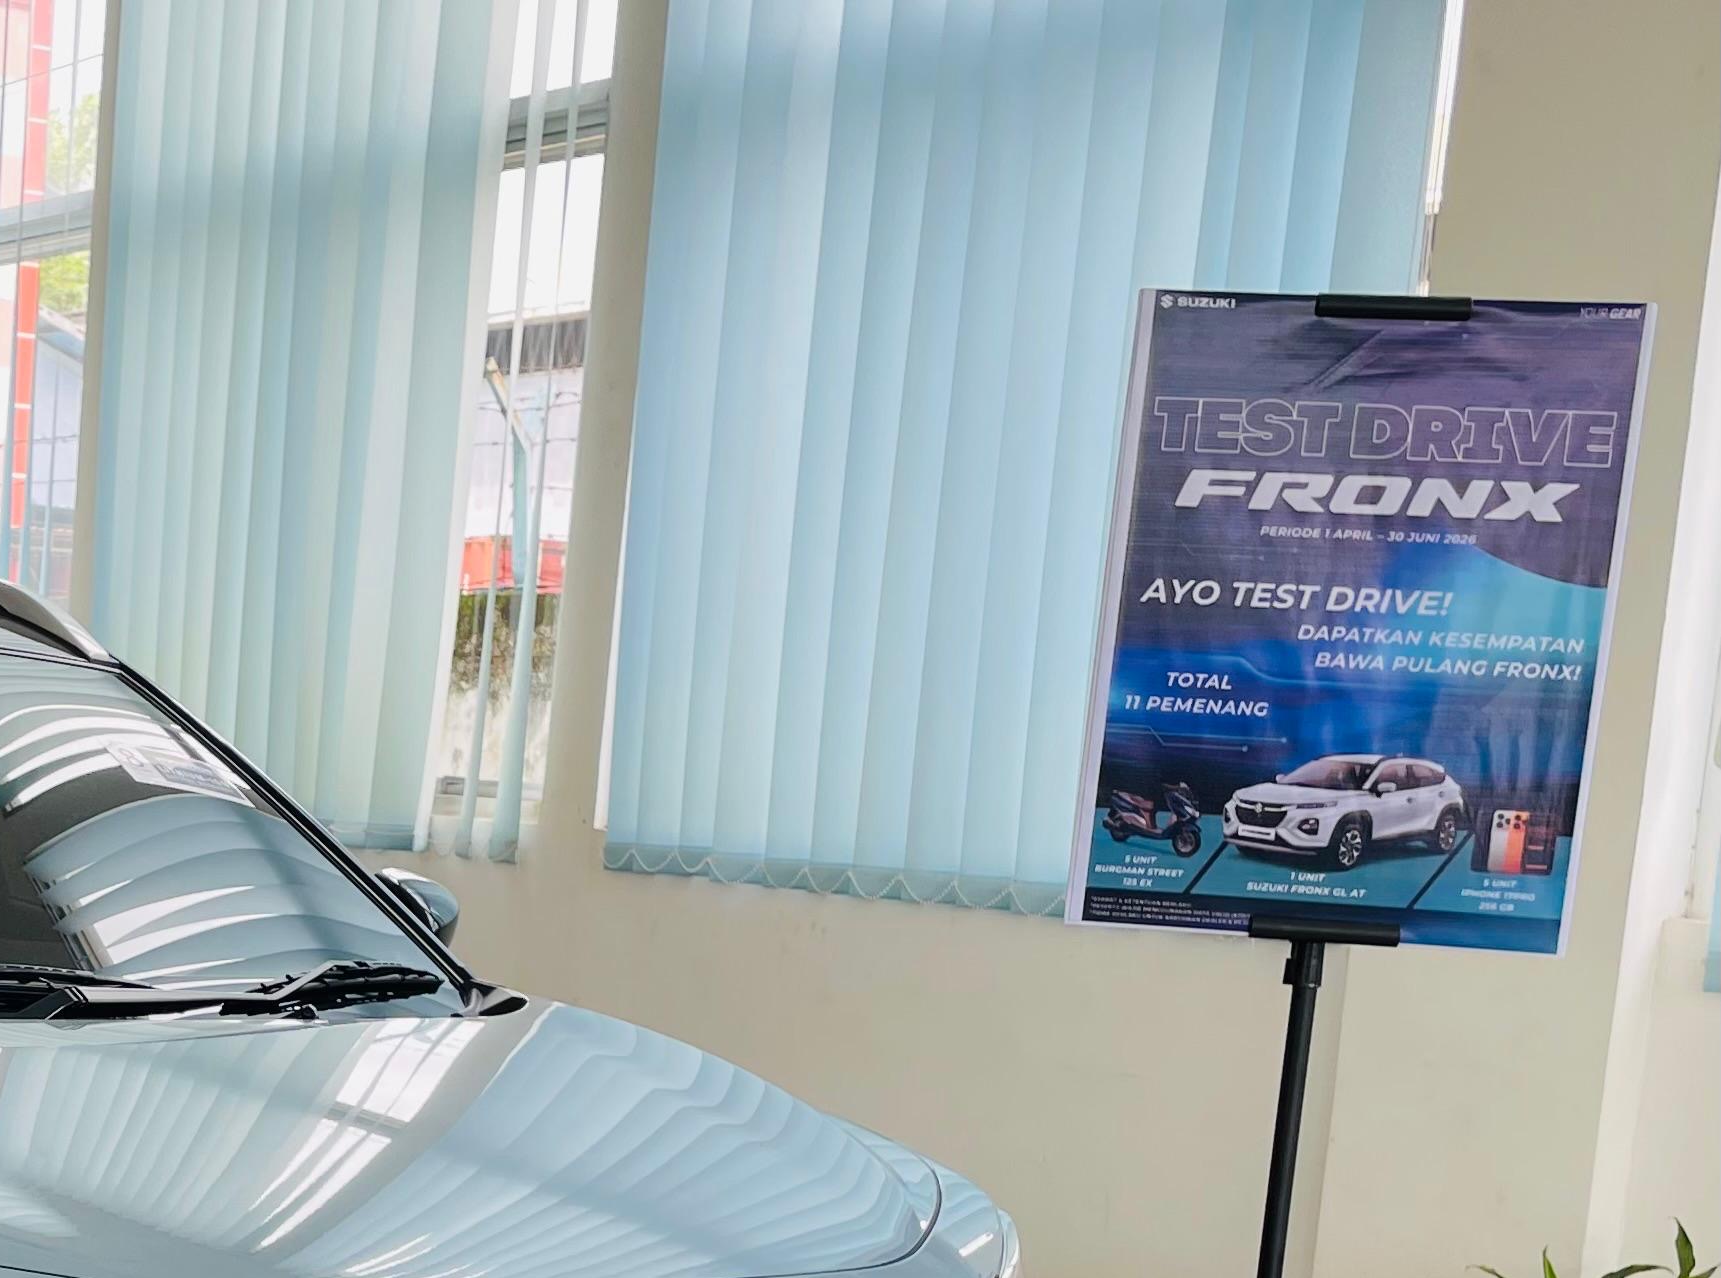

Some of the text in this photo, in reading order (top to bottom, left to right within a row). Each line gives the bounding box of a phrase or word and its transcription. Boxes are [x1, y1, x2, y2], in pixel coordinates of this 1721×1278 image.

[1177, 296, 1236, 309] SUZUKI
[1609, 307, 1641, 320] GEAR
[1154, 396, 1618, 468] TEST DRIVE
[1175, 468, 1580, 522] FRONX
[1260, 525, 1320, 539] PERIODE
[1324, 528, 1330, 538] 1
[1332, 528, 1373, 541] APRIL
[1387, 531, 1404, 542] 30
[1406, 532, 1441, 543] JUNI
[1140, 578, 1454, 617] AYO TEST DRIVE!
[1297, 624, 1585, 654] DAPATKAN KESEMPATAN
[1314, 651, 1582, 681] BAWA PULANG FRONX!
[1166, 671, 1232, 690] TOTAL
[1124, 694, 1269, 717] 11 PEMENANG
[1133, 855, 1158, 864] UNIT
[1095, 864, 1184, 877] BURGMAN STREET
[1297, 872, 1326, 882] UNIT
[1246, 881, 1367, 898] SUZUKI FRONX GL AT
